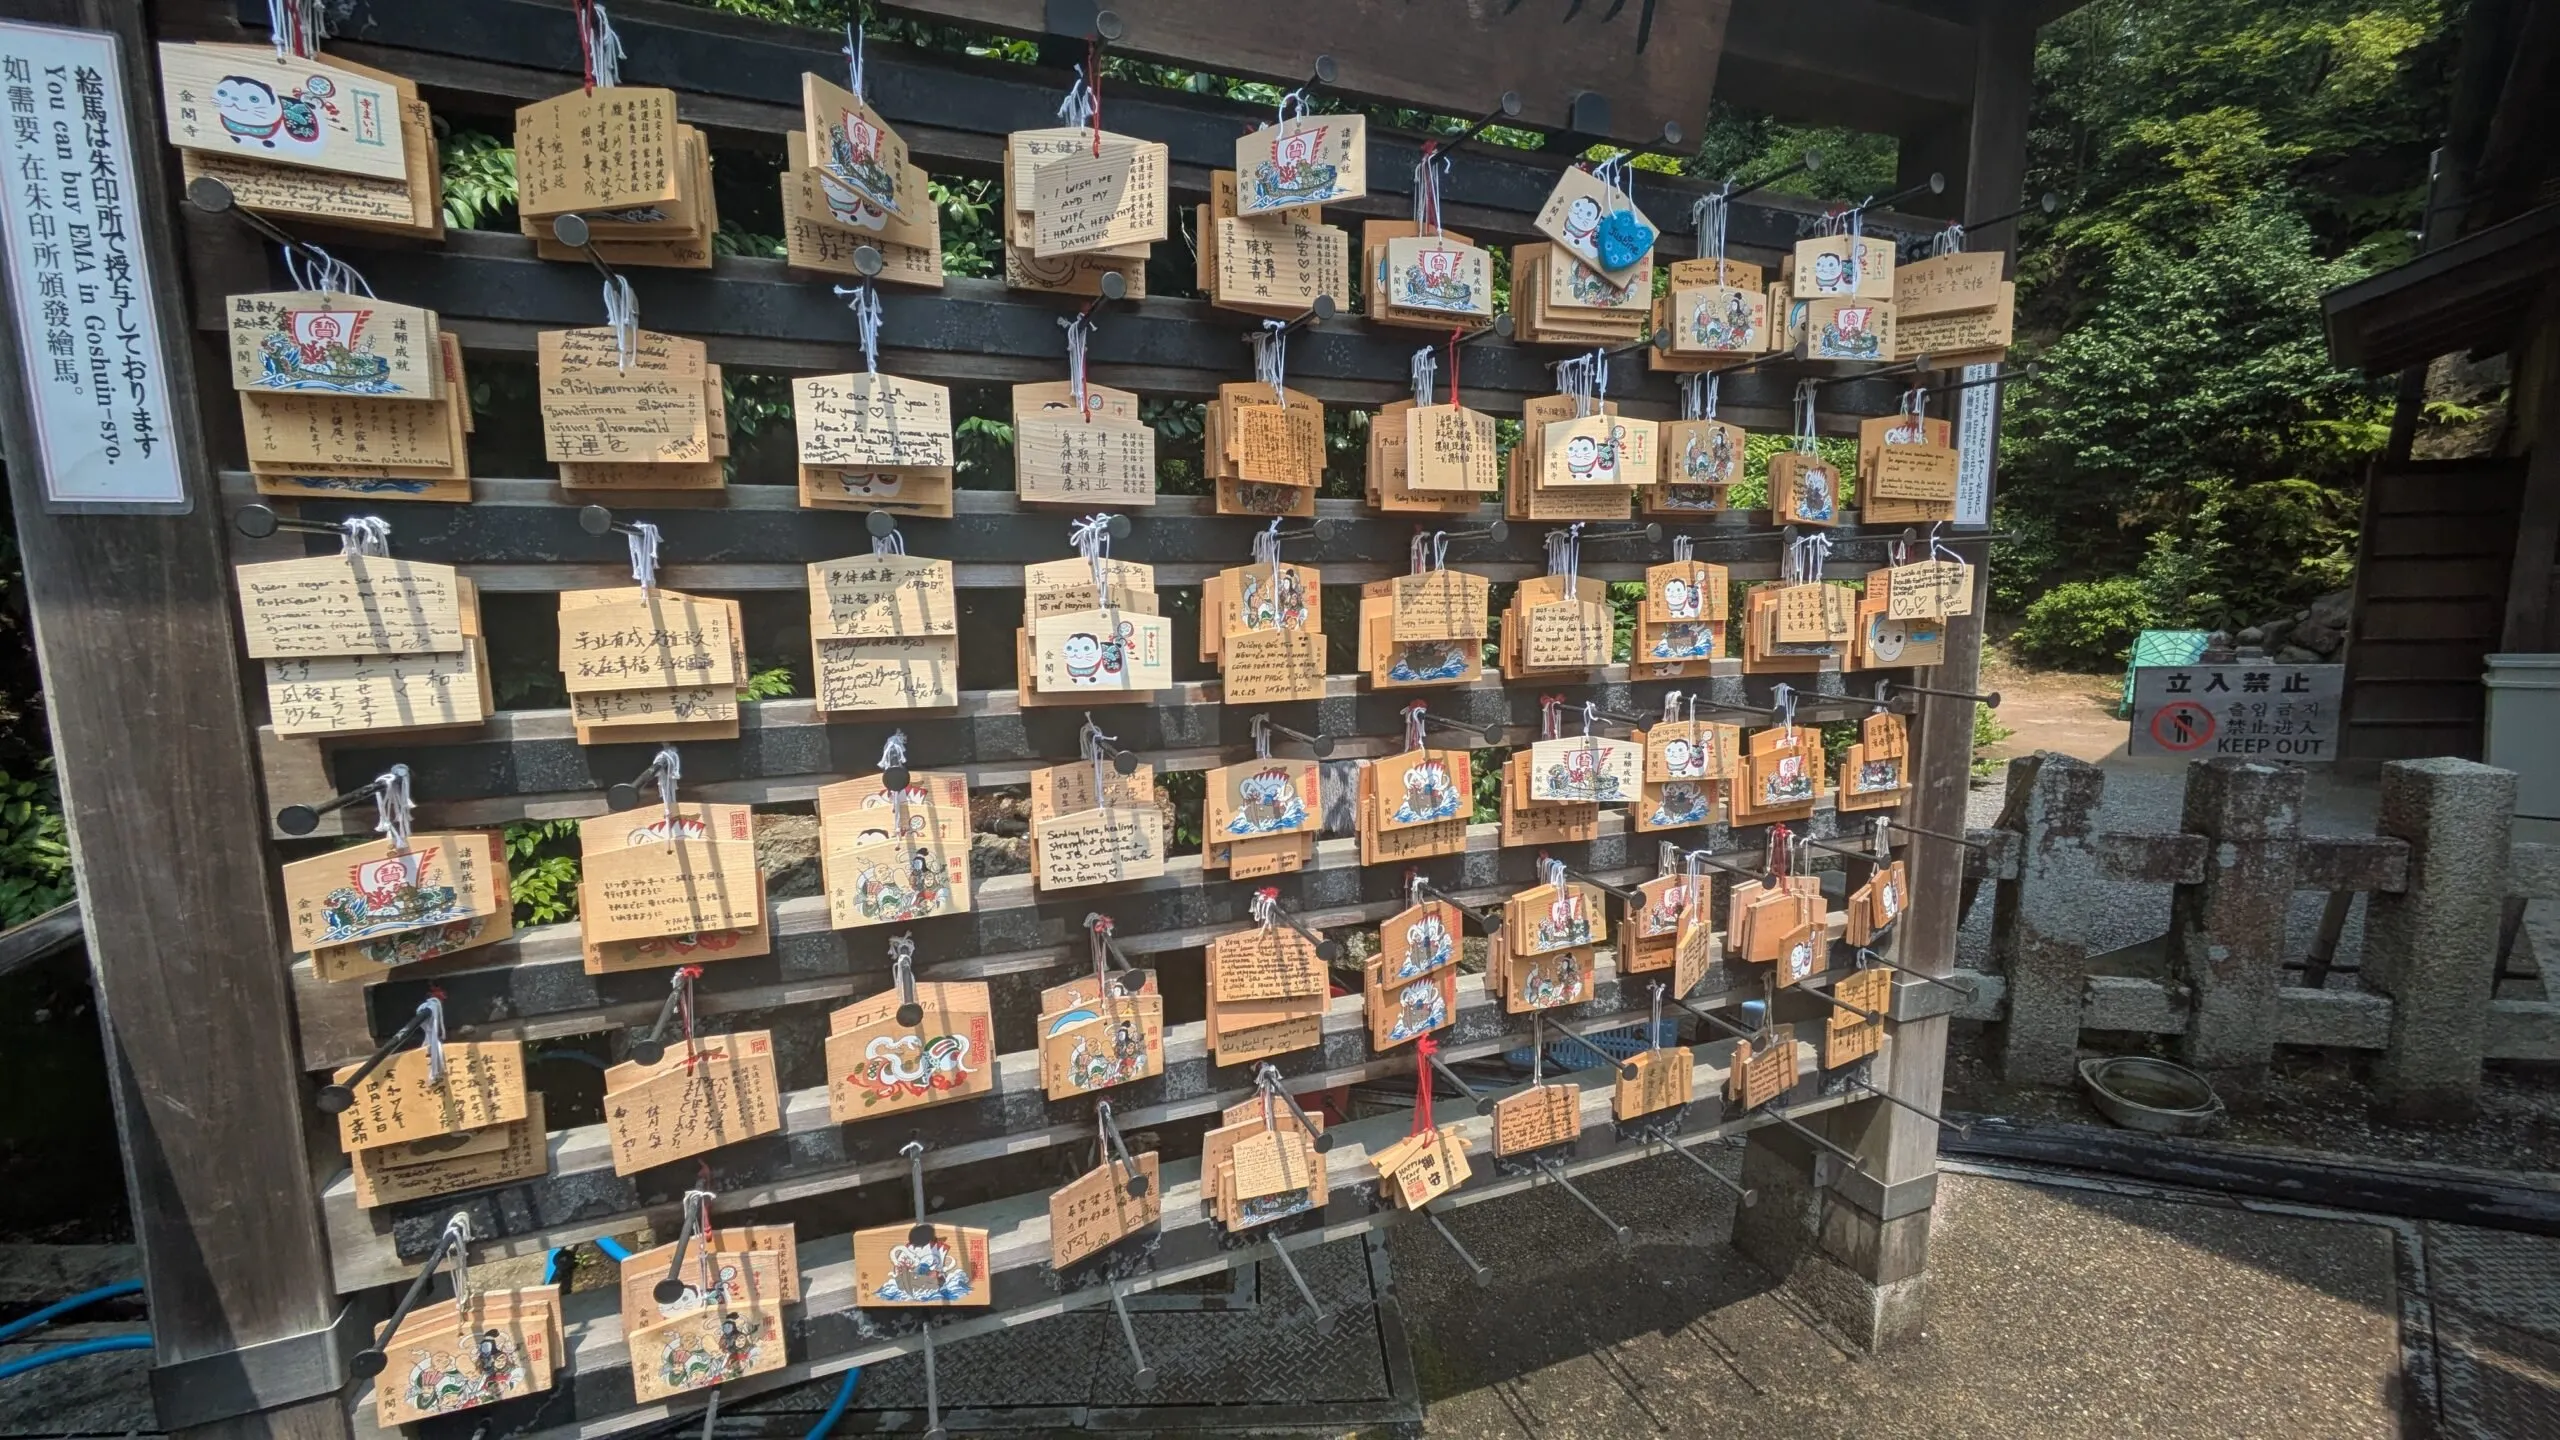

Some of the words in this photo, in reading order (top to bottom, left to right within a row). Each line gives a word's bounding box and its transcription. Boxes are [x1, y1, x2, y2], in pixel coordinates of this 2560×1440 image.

[44, 64, 68, 111] You
[178, 90, 200, 138] 金閣寺
[53, 119, 75, 161] can
[60, 170, 83, 216] buy
[1065, 179, 1092, 194] WISH
[1061, 196, 1083, 210] AND
[1092, 189, 1109, 202] MY
[1060, 210, 1086, 224] WIFE
[1076, 222, 1086, 233] A
[1090, 206, 1133, 228] HEALTHY
[69, 223, 98, 275] EMA
[79, 283, 97, 305] in
[392, 318, 410, 372] 諸願成就
[83, 315, 122, 467] Goshuin-syo.
[2165, 672, 2311, 694] 立入禁止
[2227, 702, 2320, 718] 출입금지
[2217, 738, 2271, 755] KEEP
[2276, 739, 2325, 755] OUT
[1047, 829, 1080, 843] Sending
[1083, 825, 1104, 837] love,
[1099, 835, 1129, 847] peace
[1092, 858, 1118, 867] much
[1076, 870, 1109, 884] family
